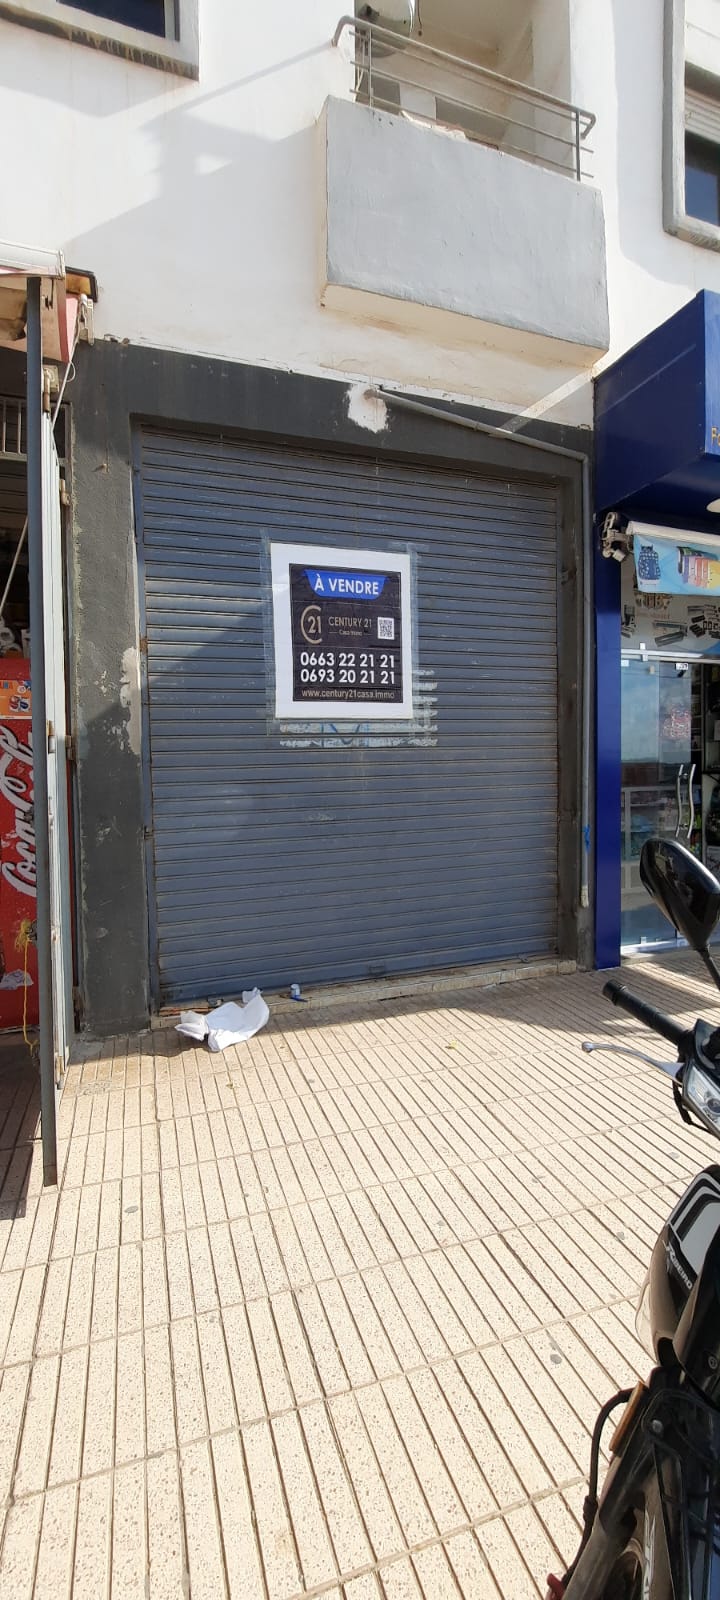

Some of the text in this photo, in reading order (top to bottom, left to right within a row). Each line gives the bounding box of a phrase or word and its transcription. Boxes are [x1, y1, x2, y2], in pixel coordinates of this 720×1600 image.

[314, 574, 379, 595] À VENDRE
[328, 616, 372, 628] CENTURY 21
[300, 651, 395, 668] 0663 22 21 21
[300, 668, 395, 684] 0693 20 21 21
[301, 689, 395, 699] www.century21casa.immo
